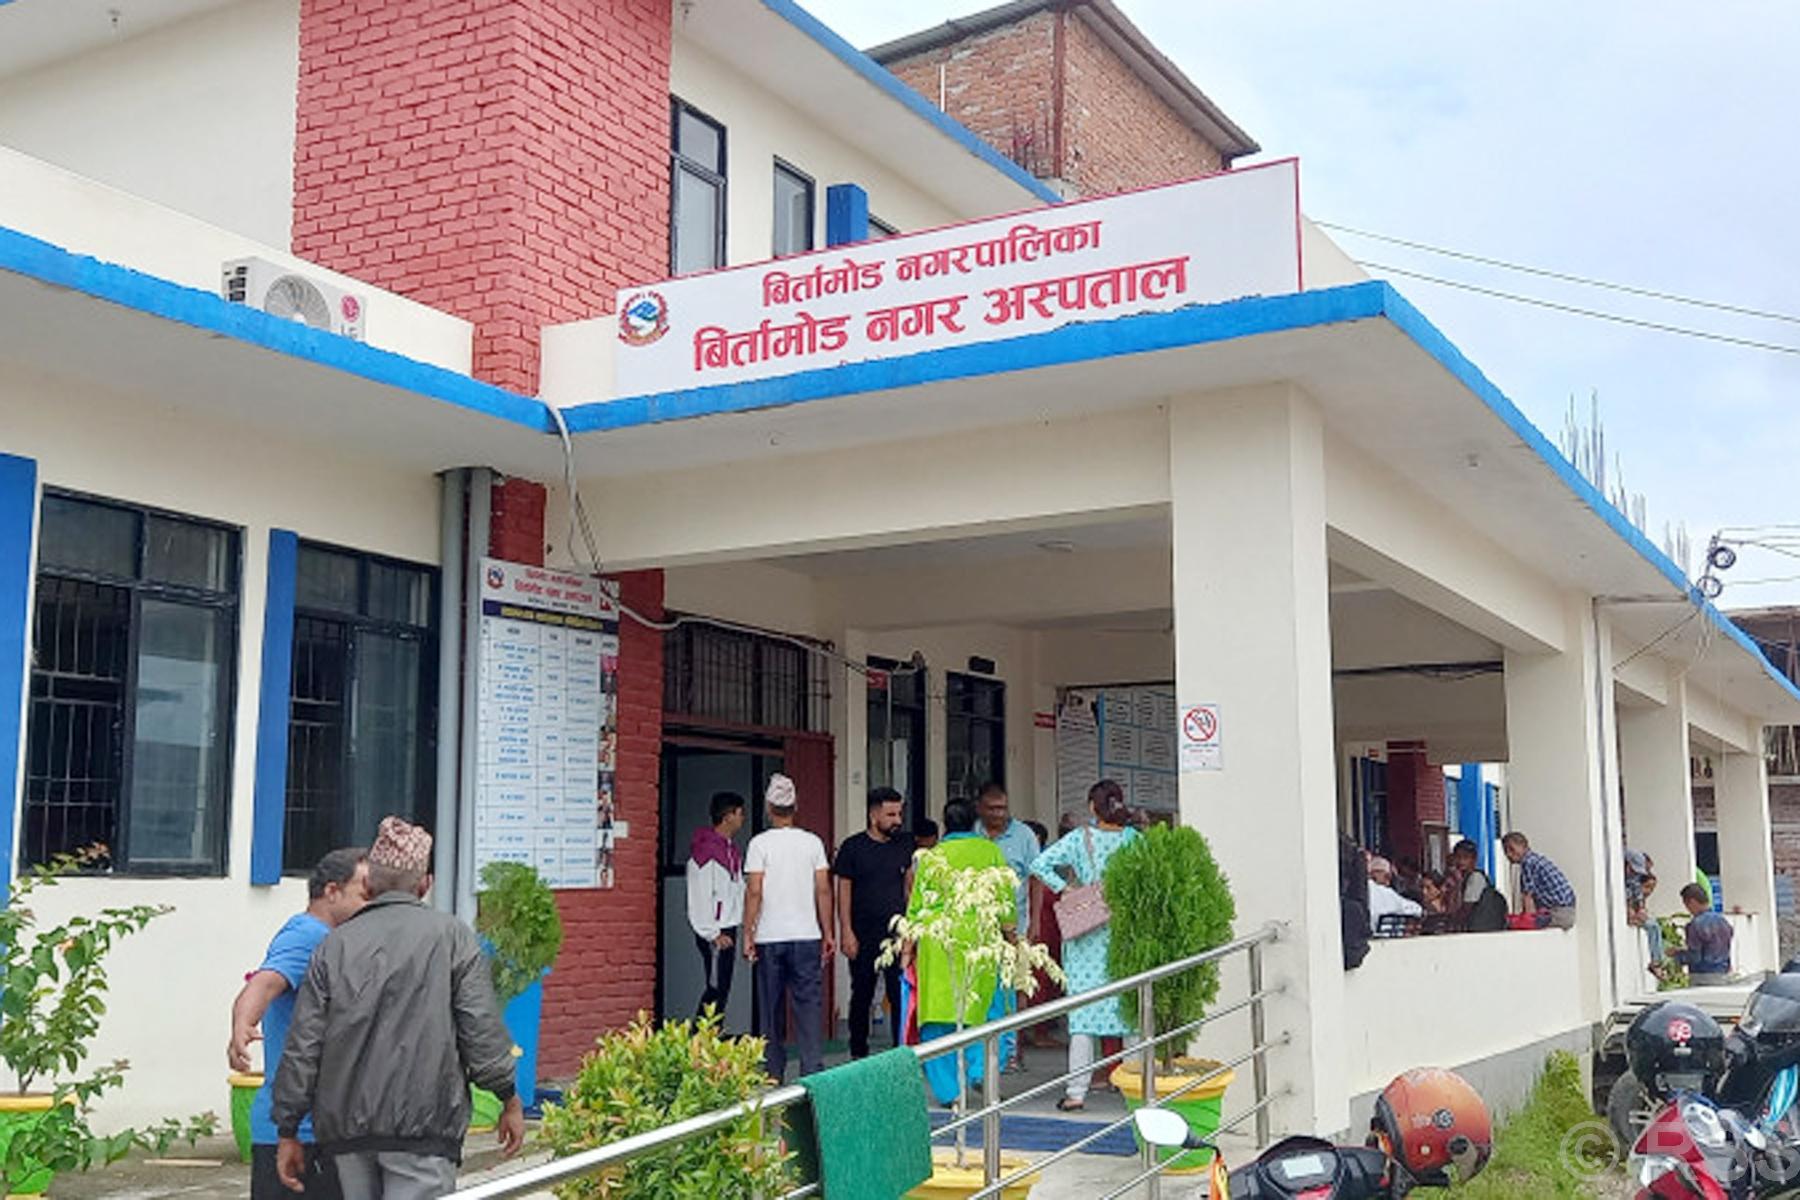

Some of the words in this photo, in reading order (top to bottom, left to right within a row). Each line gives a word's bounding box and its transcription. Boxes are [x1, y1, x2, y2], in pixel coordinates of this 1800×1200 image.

[693, 311, 850, 372] बिर्तामोड
[866, 294, 968, 343] नगर
[983, 256, 1190, 325] अस्पताल
[763, 258, 884, 307] बिर्तामोड
[896, 220, 1102, 281] नगरपालिका
